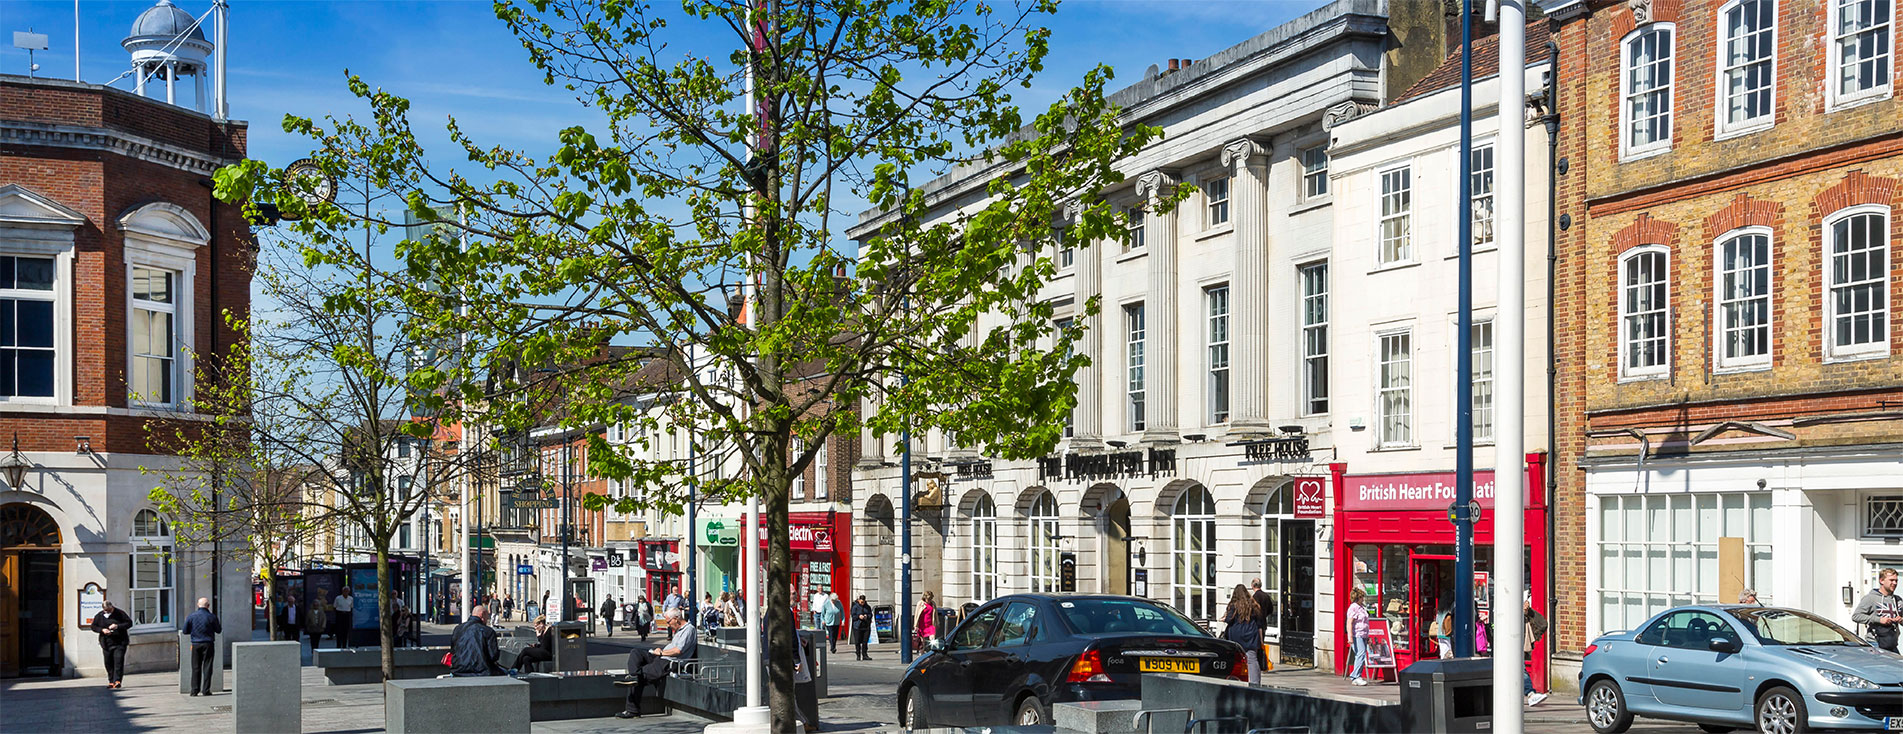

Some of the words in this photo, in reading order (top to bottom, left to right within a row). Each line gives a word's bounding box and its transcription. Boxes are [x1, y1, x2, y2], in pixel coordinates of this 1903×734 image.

[1245, 442, 1272, 458] FREE
[1274, 440, 1309, 457] HOUSE
[1148, 447, 1176, 478] INN
[1359, 484, 1396, 500] British
[1399, 483, 1432, 499] Heart
[514, 500, 553, 508] SHOPPING
[1144, 659, 1172, 670] W909
[1176, 660, 1196, 671] YNO
[1212, 661, 1227, 670] GB
[1890, 718, 1903, 728] EX
